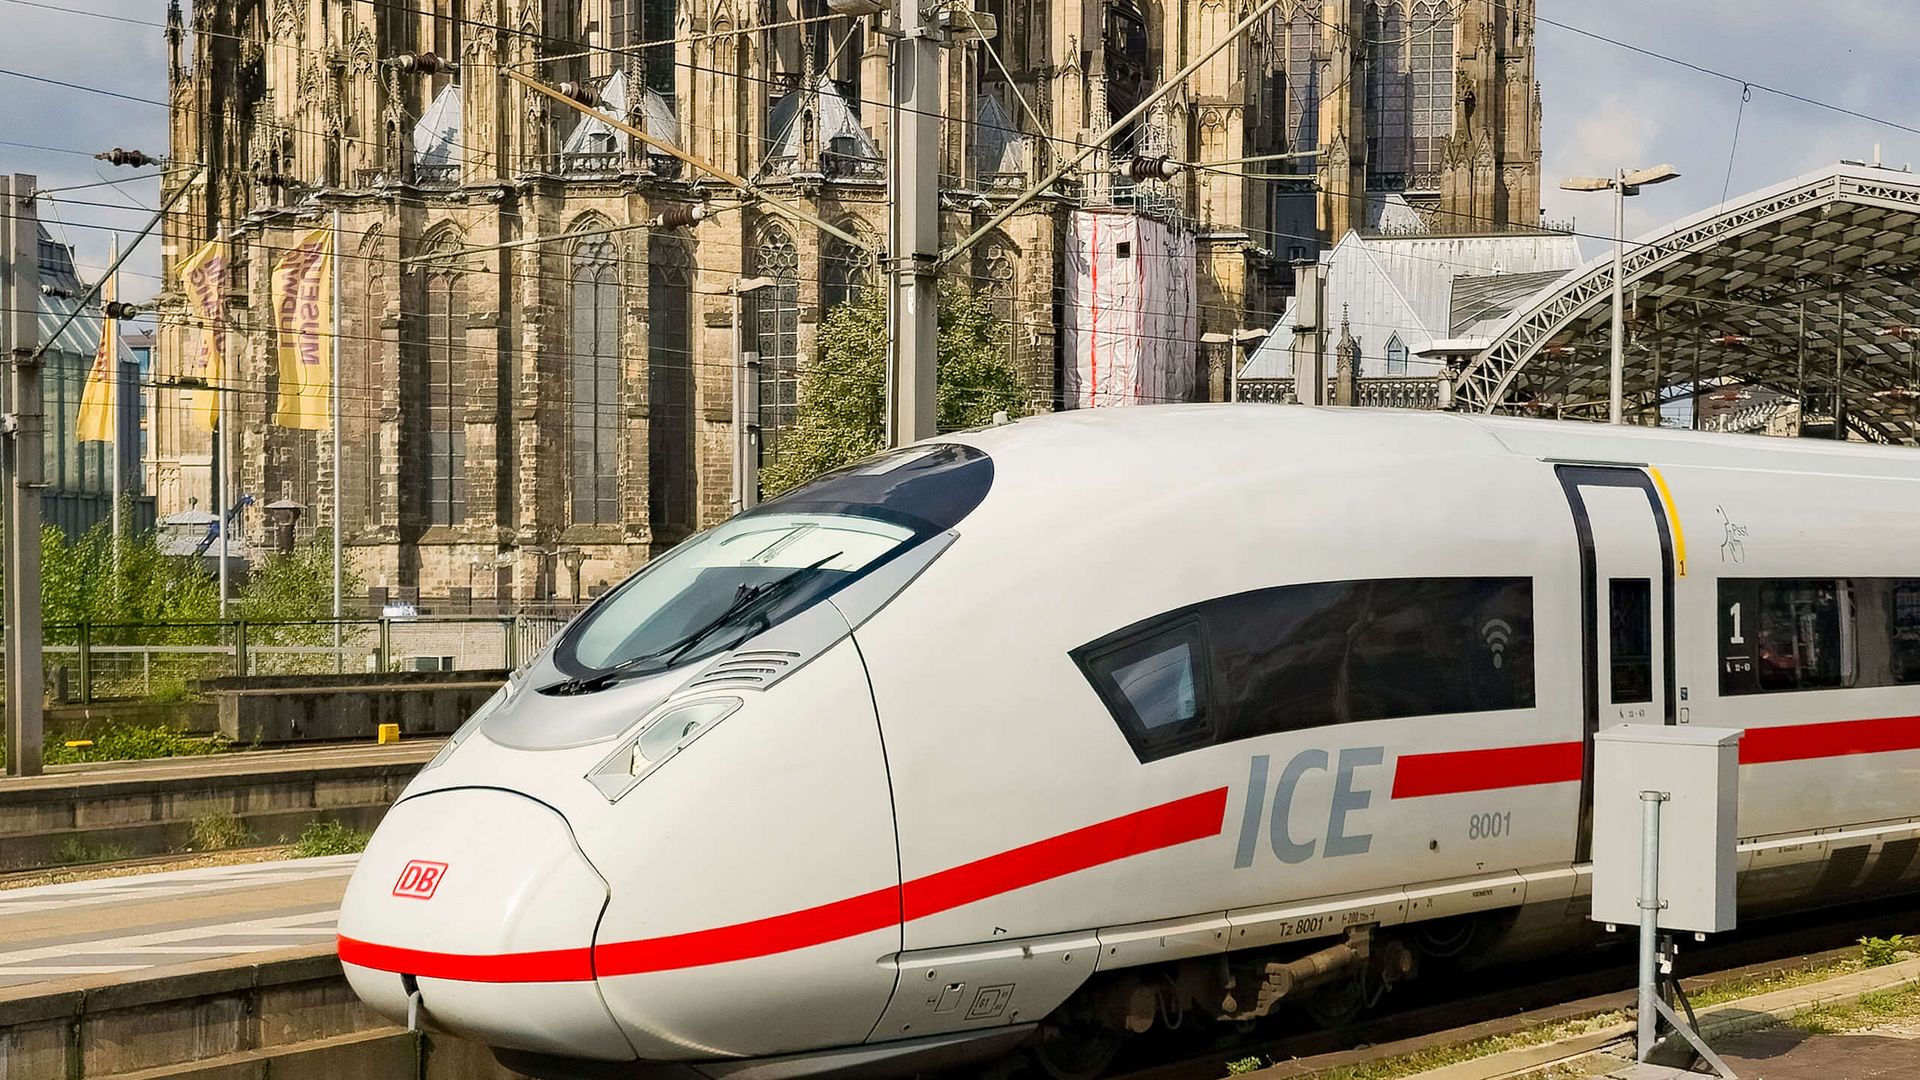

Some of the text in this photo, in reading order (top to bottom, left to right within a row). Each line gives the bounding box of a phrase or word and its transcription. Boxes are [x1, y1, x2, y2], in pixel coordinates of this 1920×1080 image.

[1679, 560, 1685, 576] 1
[1730, 602, 1744, 644] 1
[1233, 746, 1384, 869] ICE
[1468, 811, 1511, 840] 8001
[399, 866, 439, 892] DB
[1280, 922, 1294, 937] Tz
[1295, 916, 1324, 935] 8001
